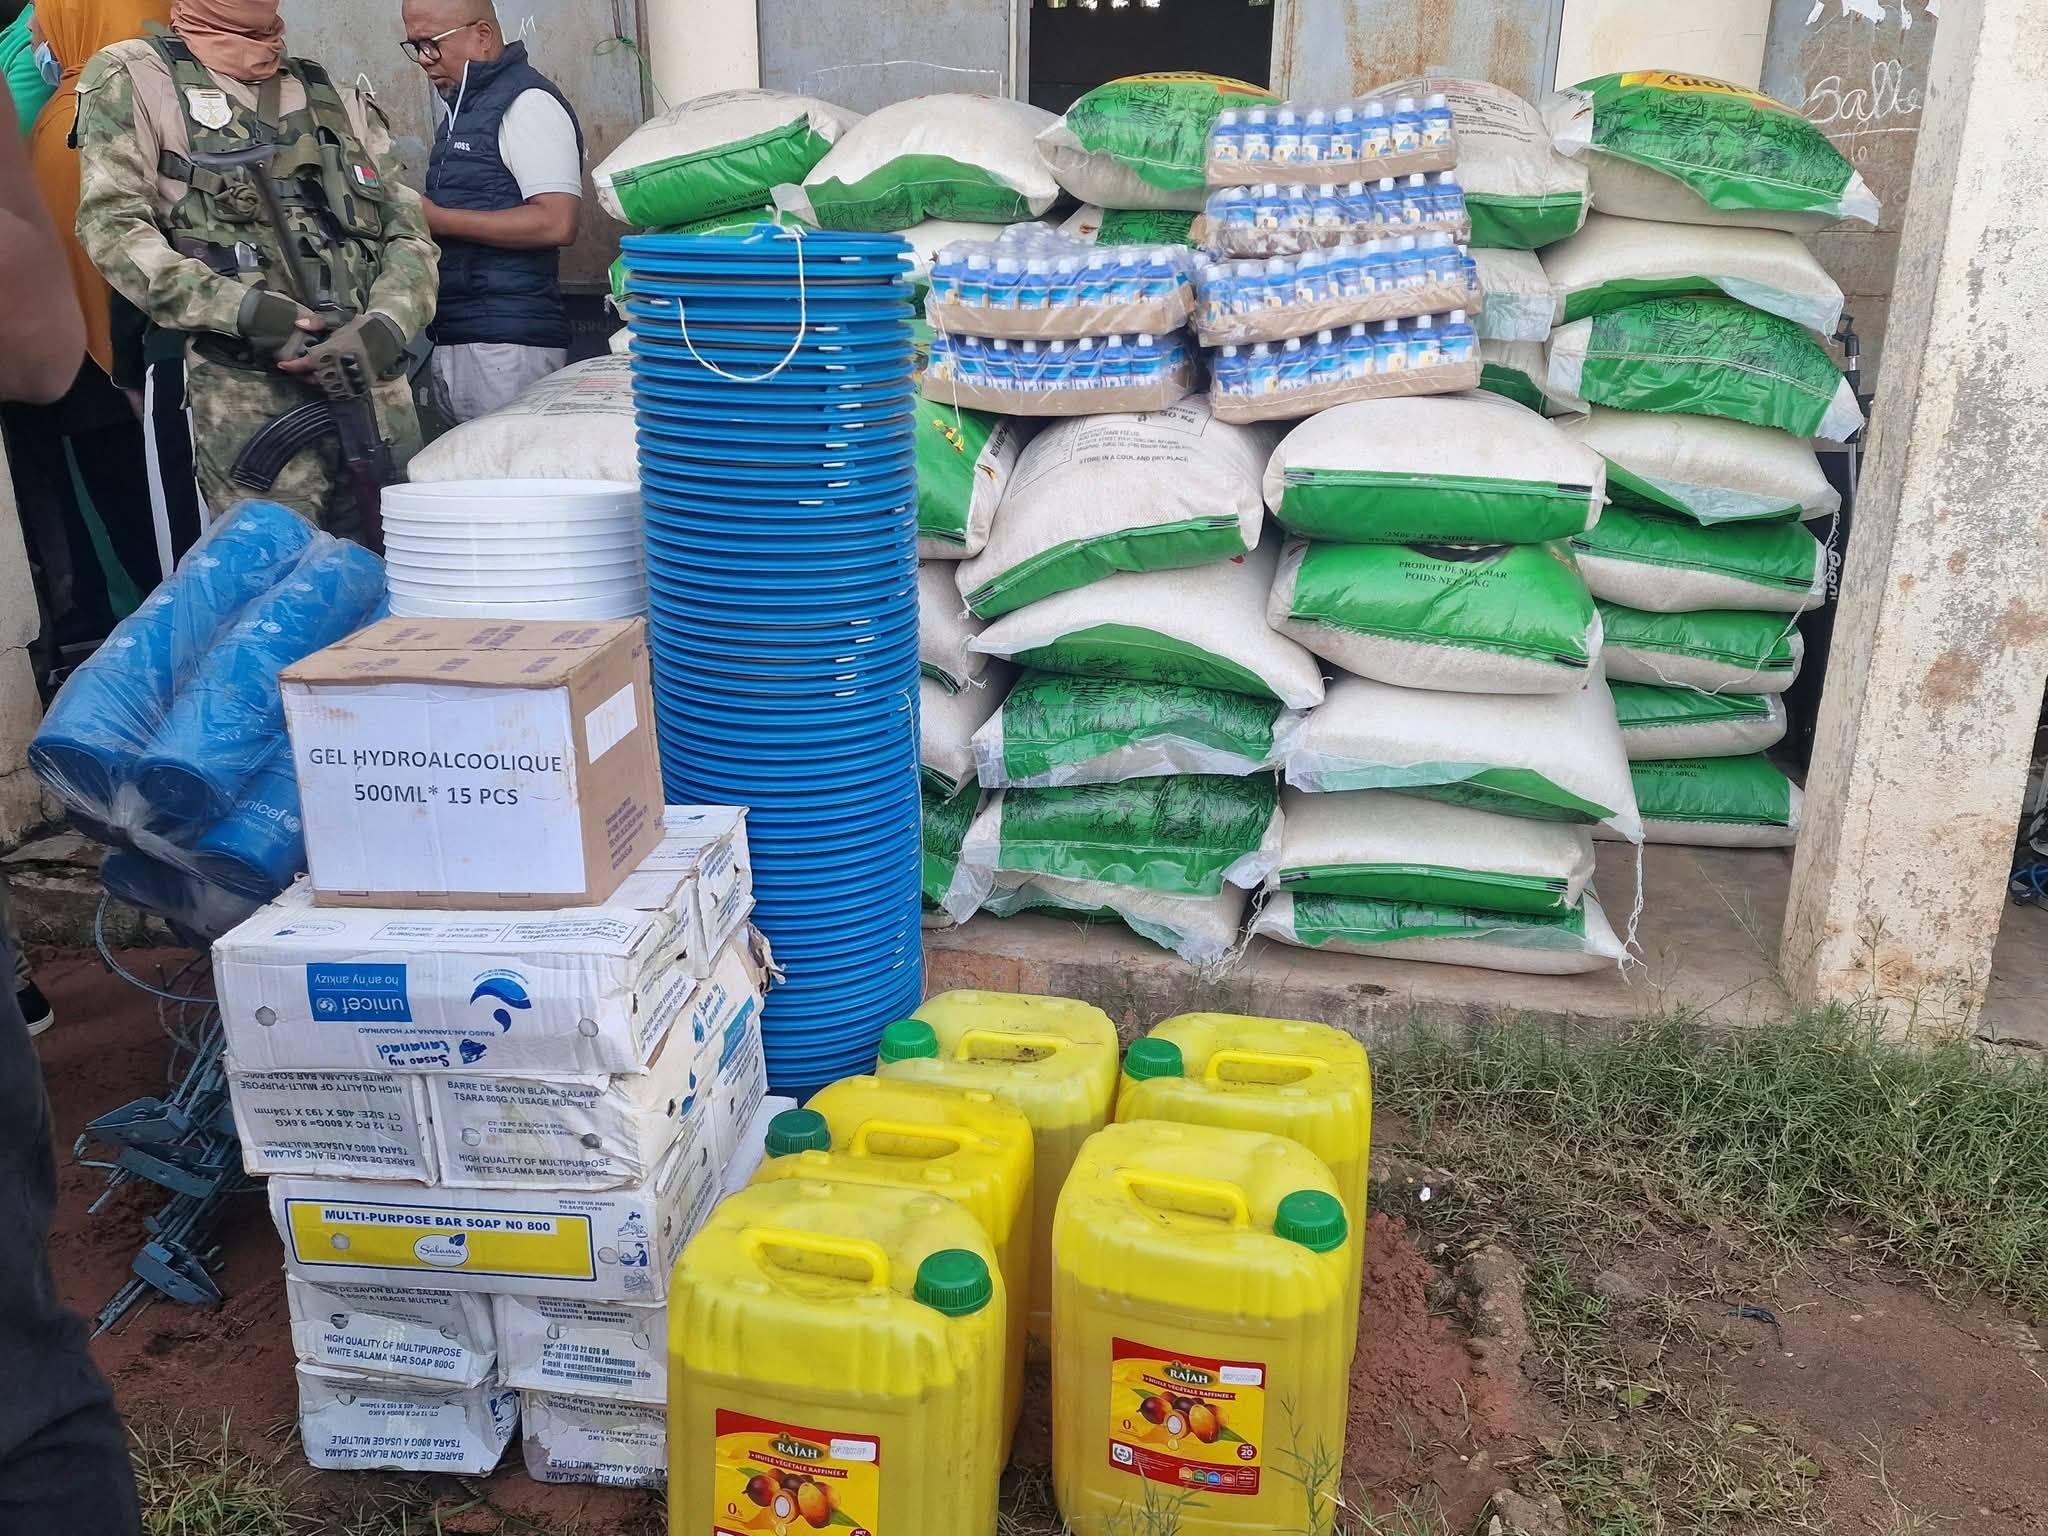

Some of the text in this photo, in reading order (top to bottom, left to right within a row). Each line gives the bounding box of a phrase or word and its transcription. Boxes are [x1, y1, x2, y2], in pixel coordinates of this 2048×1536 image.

[1399, 561, 1441, 572] PRODUIT
[1444, 566, 1457, 574] DE
[1405, 572, 1436, 583] POIDS
[309, 748, 562, 775] GEL HYDROALCOOLIQUE
[447, 787, 471, 805] 15
[479, 788, 519, 806] PCS
[313, 973, 350, 987] ankizy
[385, 975, 400, 987] ho
[341, 996, 405, 1016] unicef
[376, 1038, 451, 1056] tananao!
[388, 1054, 451, 1068] Sasao ny
[240, 1080, 402, 1094] HIGH QUALITY OF MULTI-PURPOSE
[447, 1080, 600, 1098] BARRE DE SAVON SALAMA
[454, 1092, 484, 1102] TSARA
[486, 1094, 508, 1104] 800G
[518, 1097, 550, 1107] USAGE
[254, 1107, 292, 1116] 134mm
[294, 1108, 303, 1116] X
[305, 1108, 323, 1117] 193
[324, 1109, 334, 1117] X
[336, 1109, 355, 1118] 405
[388, 1111, 401, 1121] CT
[275, 1118, 308, 1127] 9.6KG
[345, 1120, 355, 1128] X
[356, 1120, 371, 1129] PC
[373, 1122, 385, 1130] 12
[389, 1123, 403, 1132] CT:
[313, 1141, 343, 1151] USAGE
[343, 1143, 353, 1152] A
[378, 1146, 409, 1156] TSARA
[263, 1149, 303, 1159] SALAMA
[370, 1155, 384, 1165] DE
[385, 1156, 416, 1167] BARRE
[458, 1153, 612, 1168] HIGH QUALITY OF MULTIPURPOSE
[464, 1164, 494, 1174] WHITE
[495, 1165, 534, 1176] SALAMA
[536, 1168, 557, 1177] BAR
[558, 1168, 584, 1177] SOAP
[324, 1209, 432, 1226] MULTI-PURPOSE
[435, 1215, 463, 1228] BAR
[465, 1217, 502, 1230] SOAP
[527, 1220, 551, 1232] 800
[419, 1243, 463, 1257] Salama
[353, 1286, 384, 1295] SAVON
[385, 1286, 416, 1296] BLANC
[416, 1288, 453, 1298] SALAMA
[408, 1296, 450, 1306] MULTIPLE
[323, 1333, 462, 1358] HIGH QUALITY OF MULTIPURPOSE
[326, 1346, 351, 1358] WHITE
[353, 1348, 388, 1362] SALAMA
[408, 1355, 433, 1367] SOAP
[434, 1359, 456, 1370] 800G
[541, 1367, 565, 1378] Website:
[1169, 1369, 1209, 1384] RAJAH
[547, 1400, 613, 1417] MULTIPURPOSE
[598, 1400, 616, 1410] BAR
[331, 1435, 461, 1448] TSARA 800G A USAGE MULTIPLE
[324, 1448, 464, 1461] BARRE DE SAVON BLANC SALAMA
[777, 1441, 818, 1459] RAJAH
[1240, 1449, 1253, 1457] 20
[550, 1458, 593, 1470] MULTIPLE
[593, 1462, 624, 1472] USAGE
[624, 1464, 632, 1473] A
[545, 1471, 580, 1481] SALAMA
[581, 1474, 610, 1484] BLANC
[610, 1475, 641, 1486] SAVON
